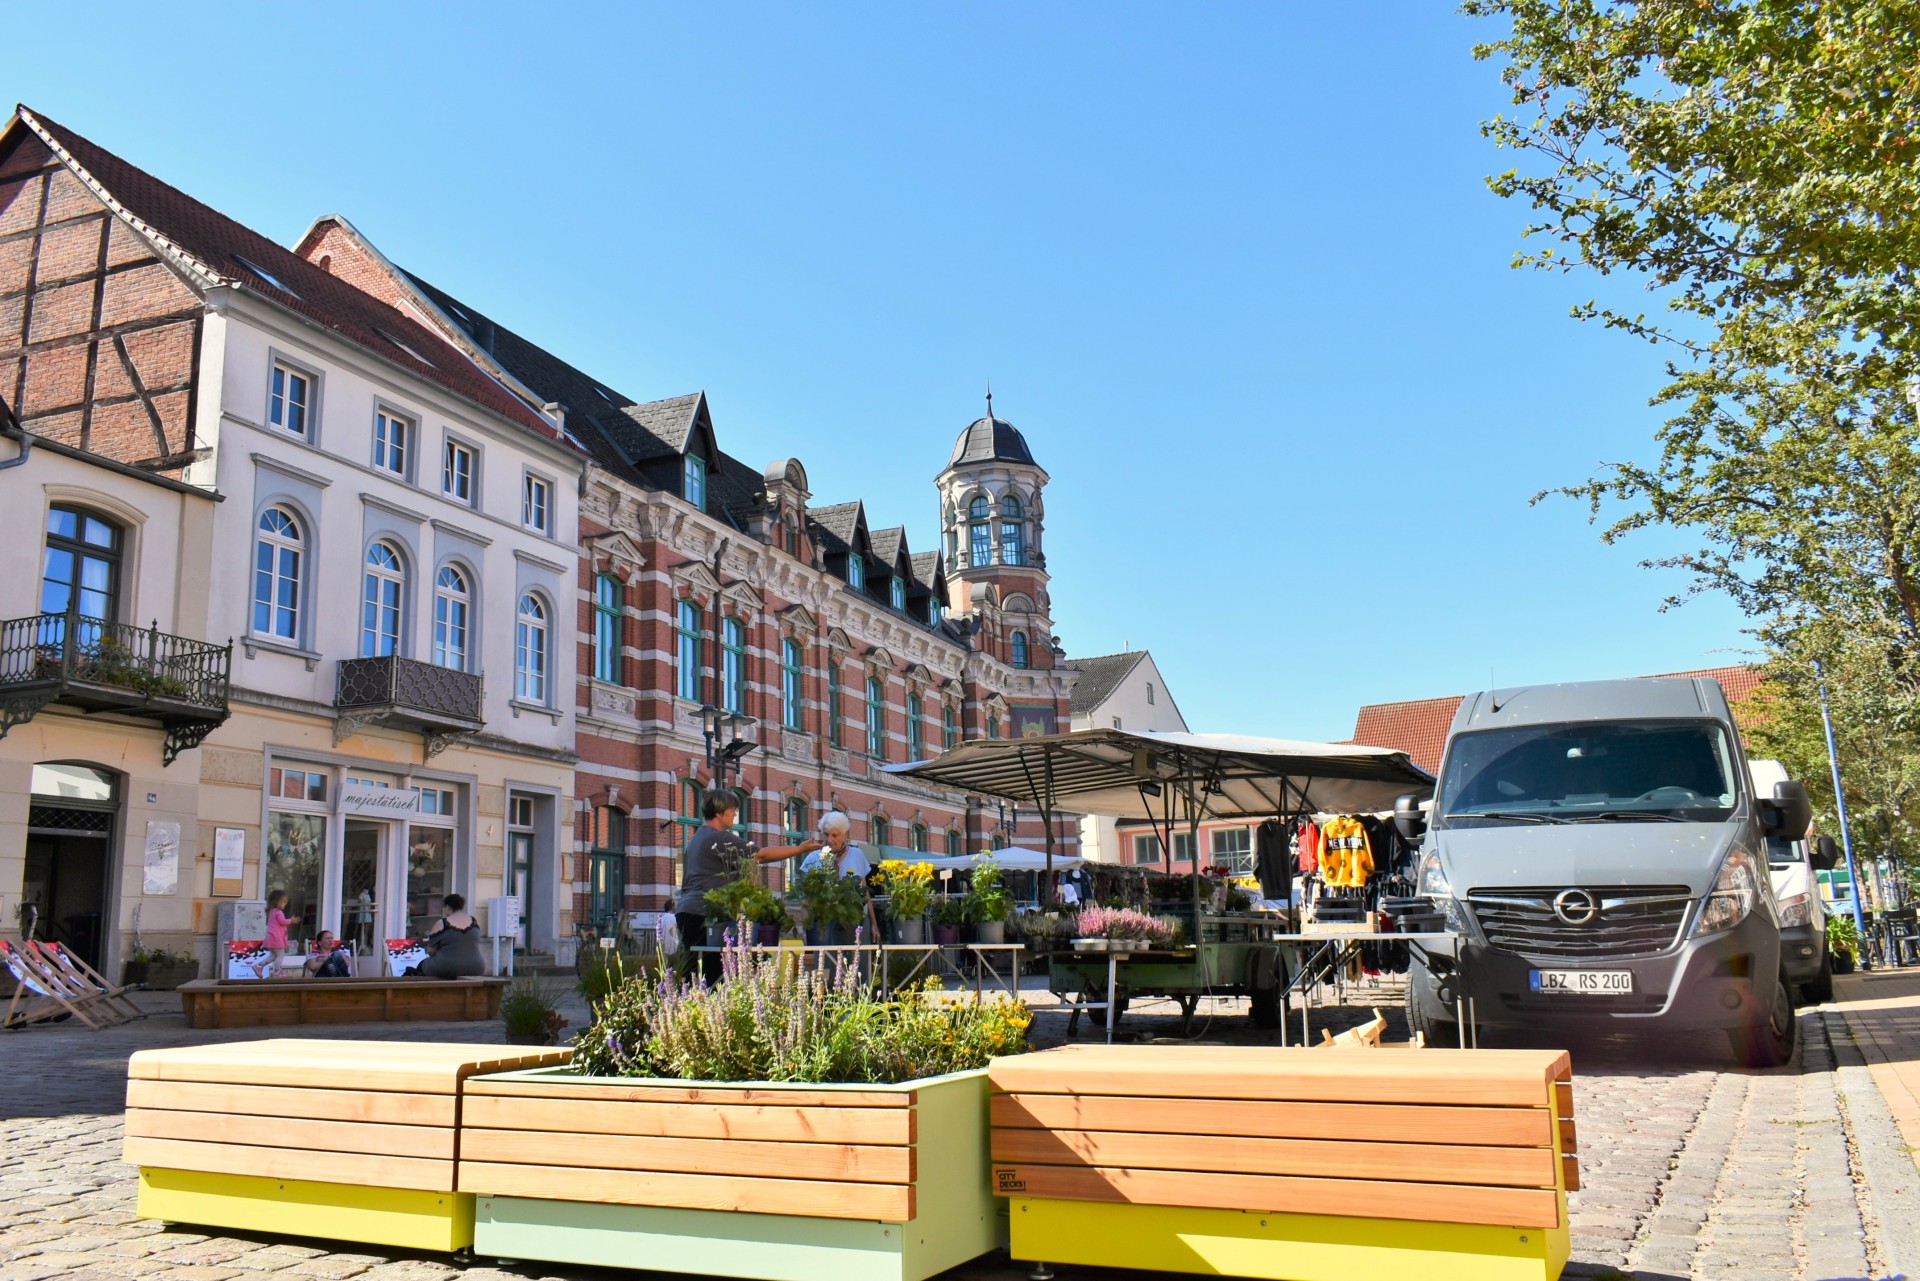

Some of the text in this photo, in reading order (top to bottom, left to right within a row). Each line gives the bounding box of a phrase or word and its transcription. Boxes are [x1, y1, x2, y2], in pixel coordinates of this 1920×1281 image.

[345, 793, 416, 811] majestätisch
[1540, 974, 1629, 988] LBZ RS 200
